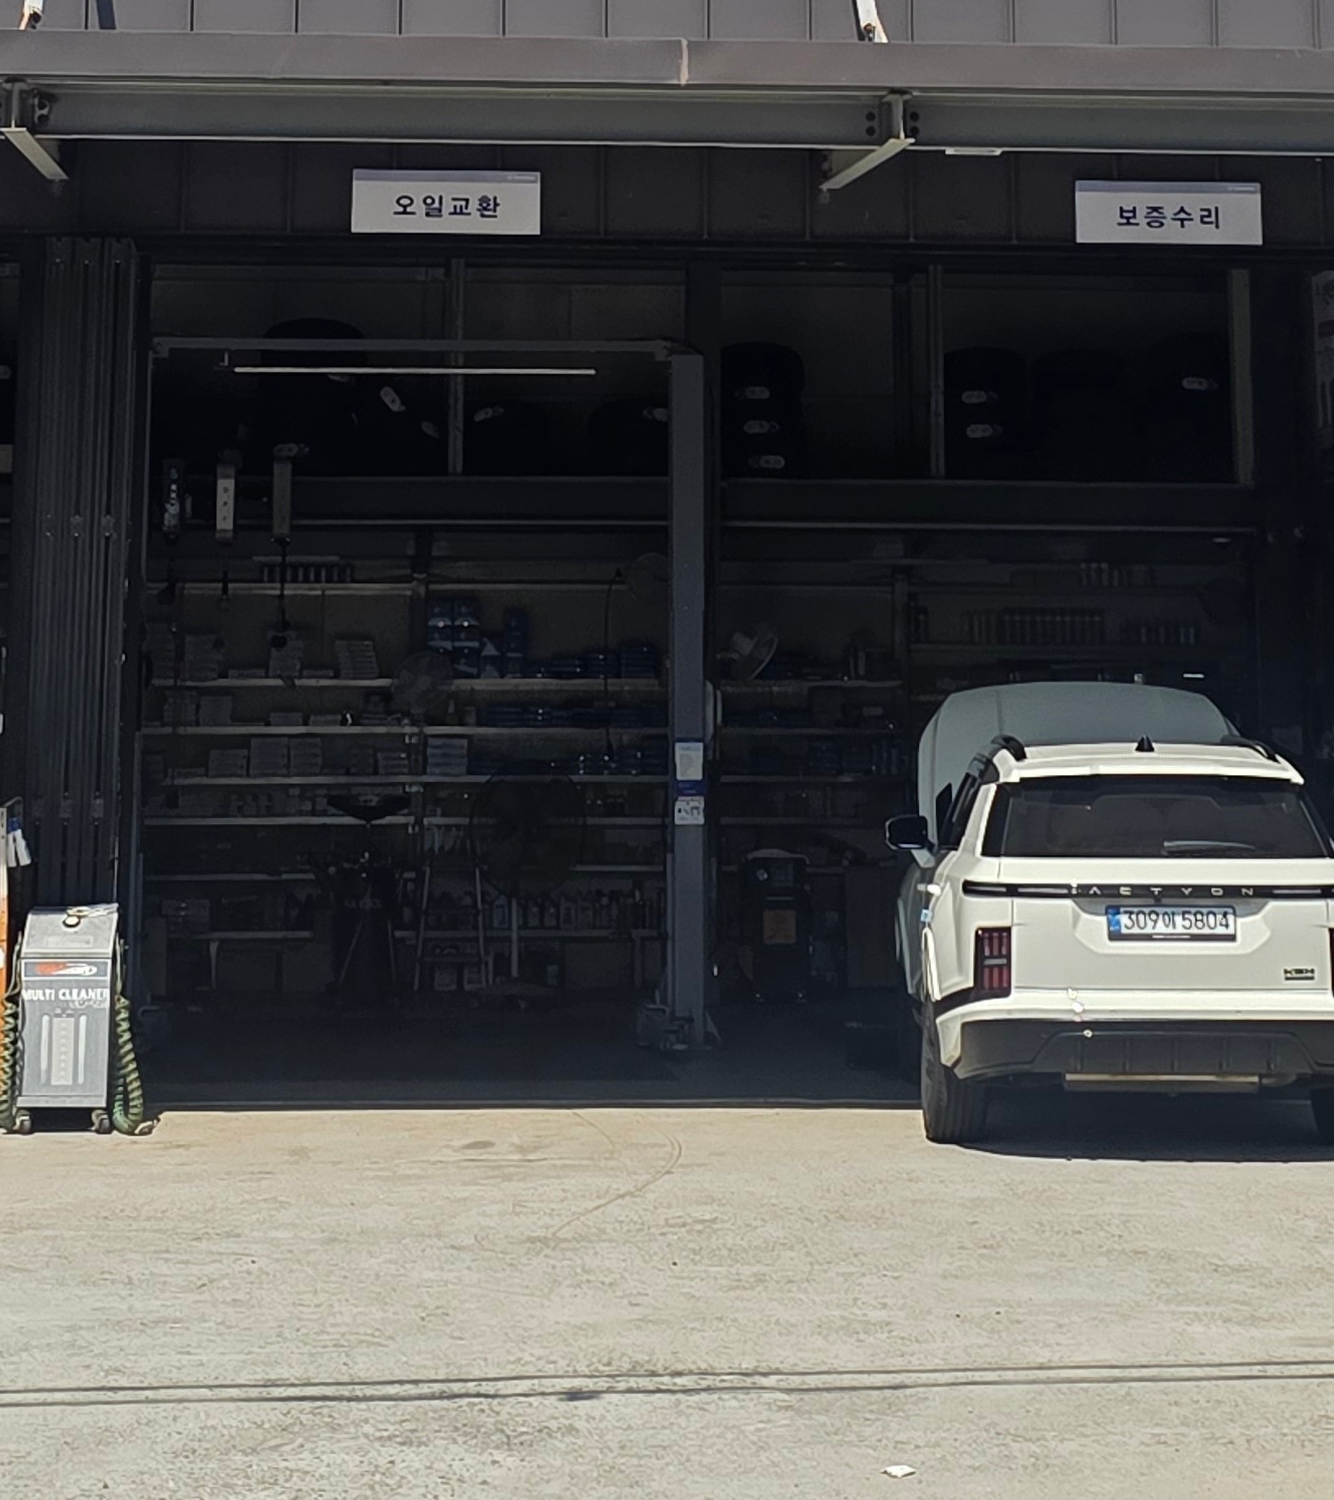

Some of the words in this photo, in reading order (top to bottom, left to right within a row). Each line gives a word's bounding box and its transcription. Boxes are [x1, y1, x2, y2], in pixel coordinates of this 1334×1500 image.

[393, 194, 501, 219] 오일교환
[1116, 205, 1221, 230] 보증수리
[1088, 886, 1254, 896] ACTYON
[1181, 909, 1231, 931] 5804
